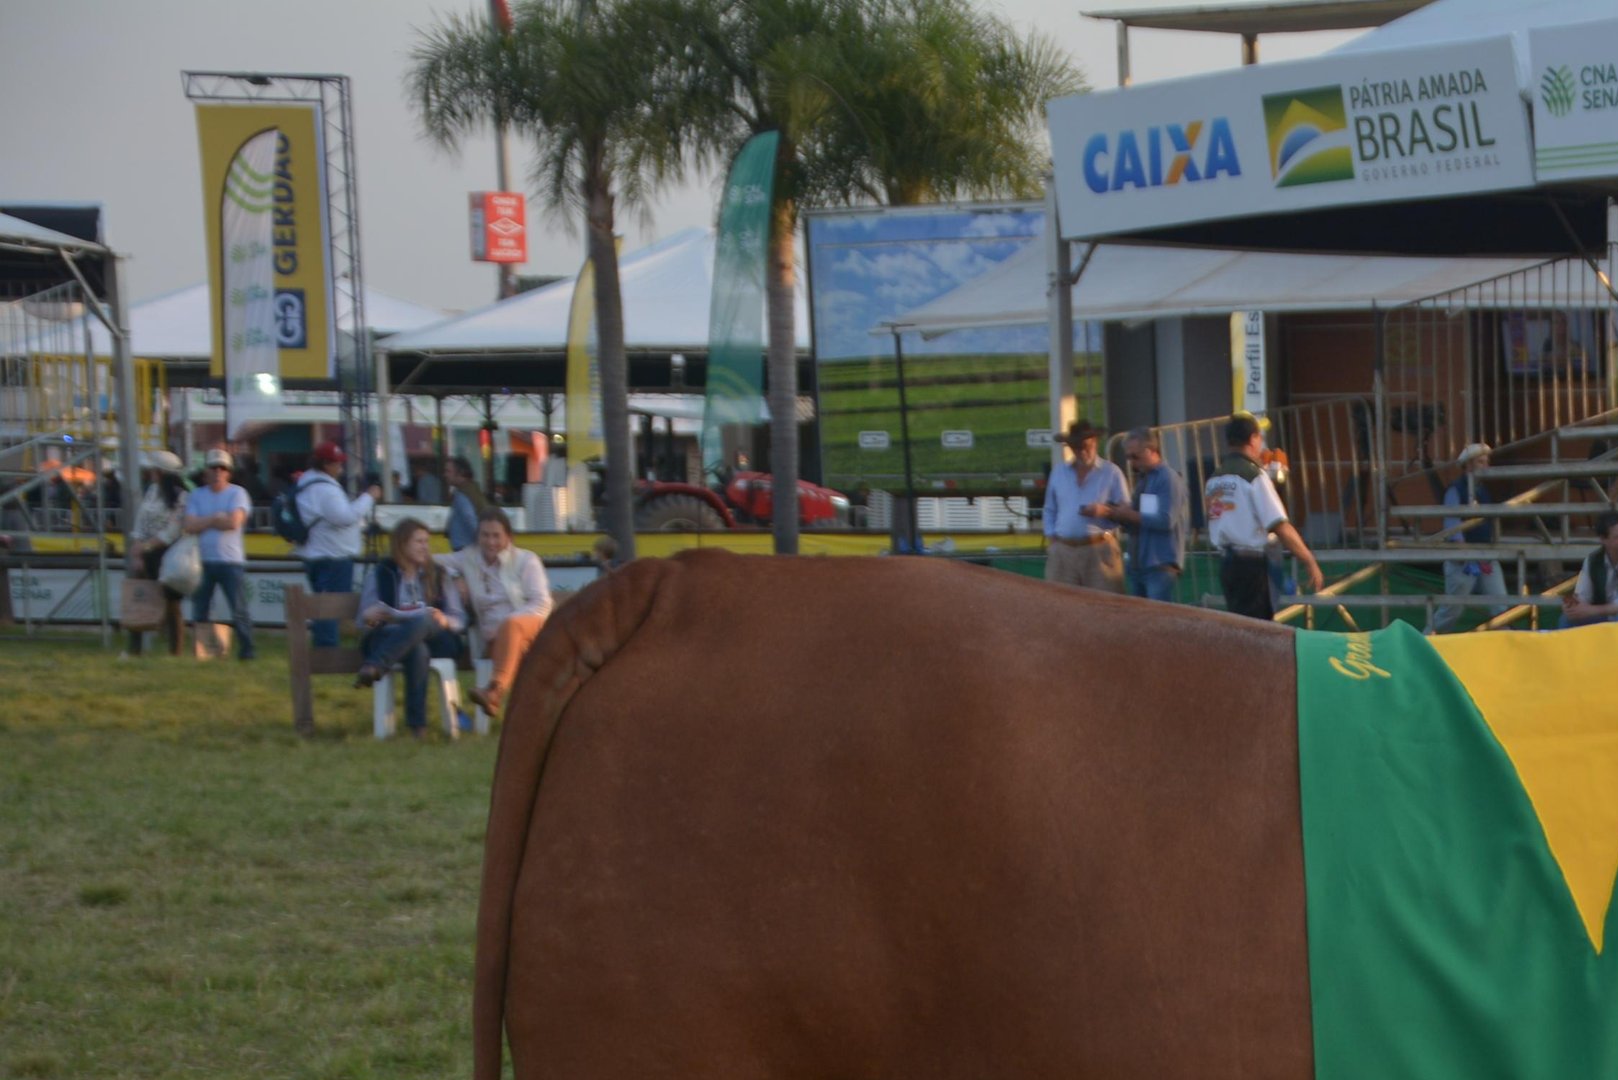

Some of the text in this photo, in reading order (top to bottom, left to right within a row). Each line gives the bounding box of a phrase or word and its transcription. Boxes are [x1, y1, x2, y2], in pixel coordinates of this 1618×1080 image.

[1350, 68, 1488, 110] PÁTRIA AMADA
[1580, 63, 1618, 86] CNA
[1354, 100, 1496, 162] BRASIL
[1083, 116, 1242, 194] CAIXA
[1362, 153, 1502, 181] GOVERNO FEDERAL
[1245, 345, 1261, 395] Perfil
